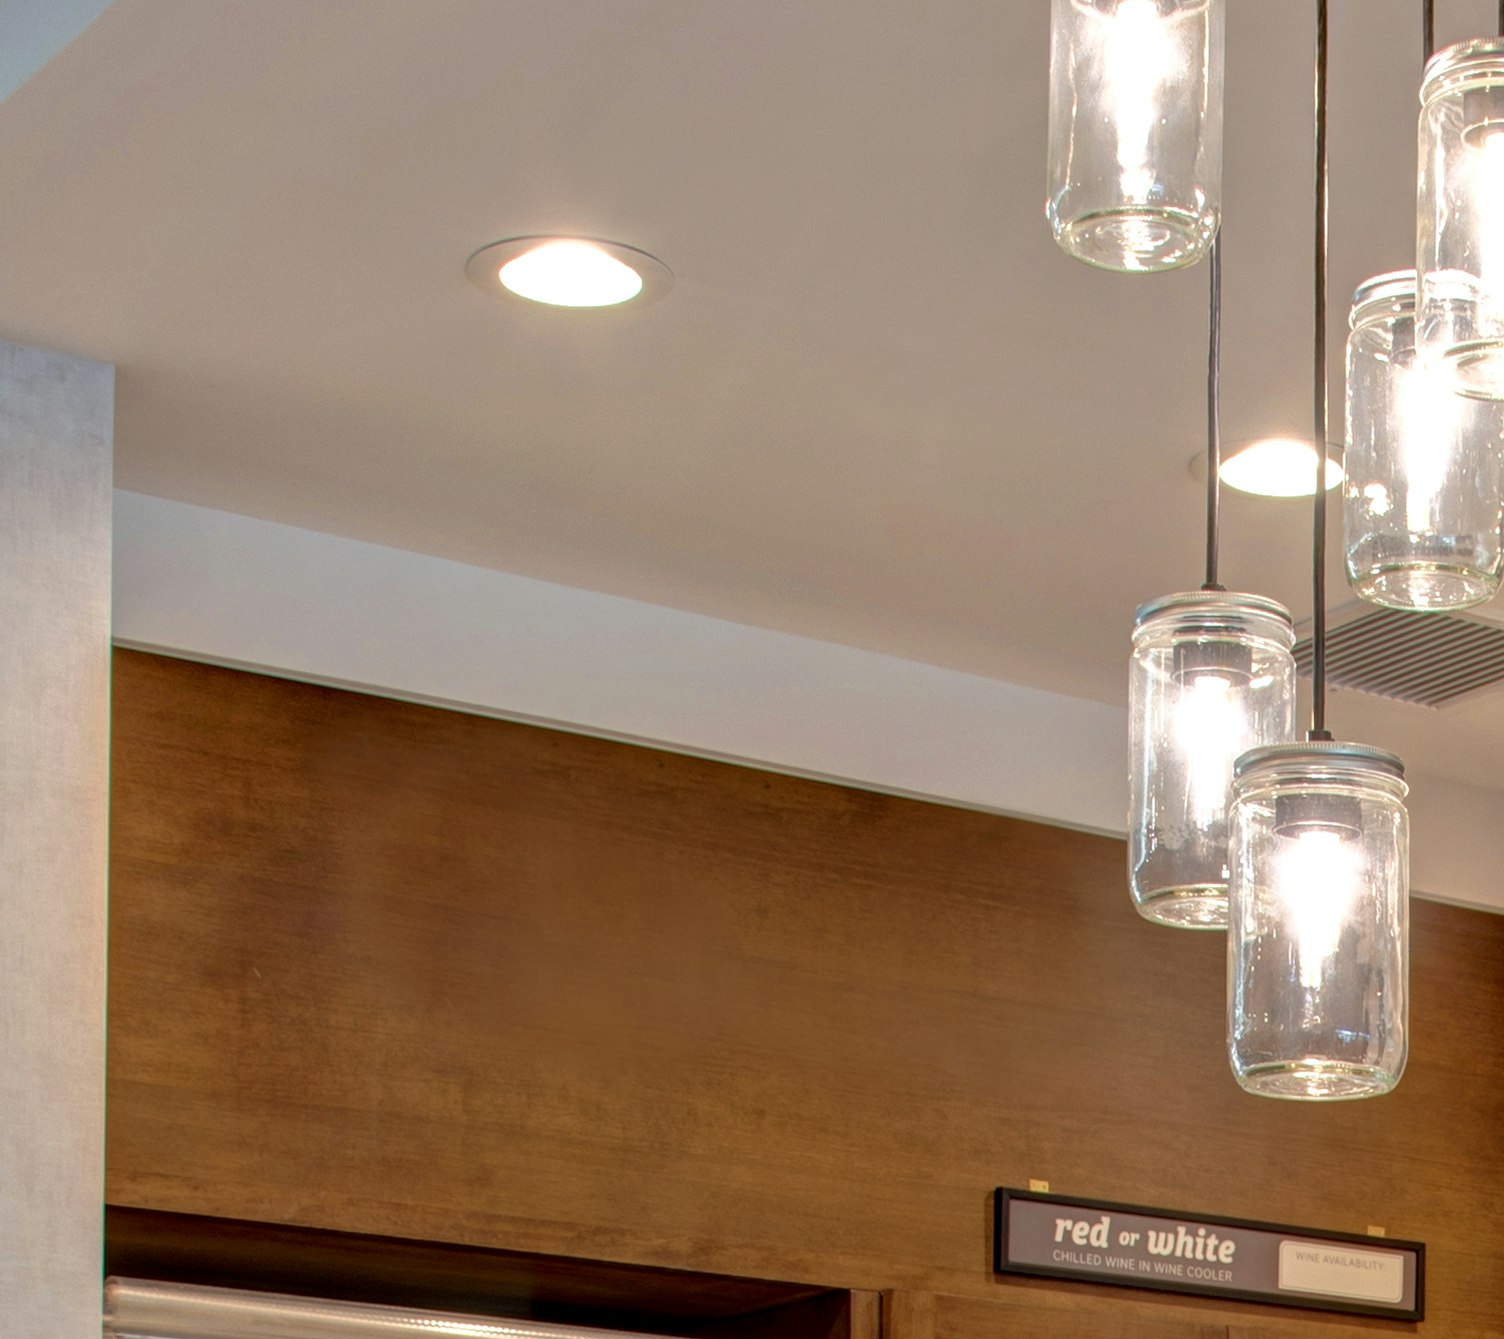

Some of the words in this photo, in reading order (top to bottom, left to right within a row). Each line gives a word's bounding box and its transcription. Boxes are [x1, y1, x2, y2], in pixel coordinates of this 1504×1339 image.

[1054, 1217, 1111, 1248] red
[1119, 1232, 1140, 1247] or
[1147, 1227, 1235, 1263] white
[1053, 1250, 1101, 1266] CHILLED
[1105, 1256, 1135, 1270] WINE
[1139, 1261, 1151, 1273] IN
[1154, 1263, 1183, 1277] WINE
[1186, 1265, 1232, 1282] COOLER
[1295, 1252, 1320, 1264] WINE
